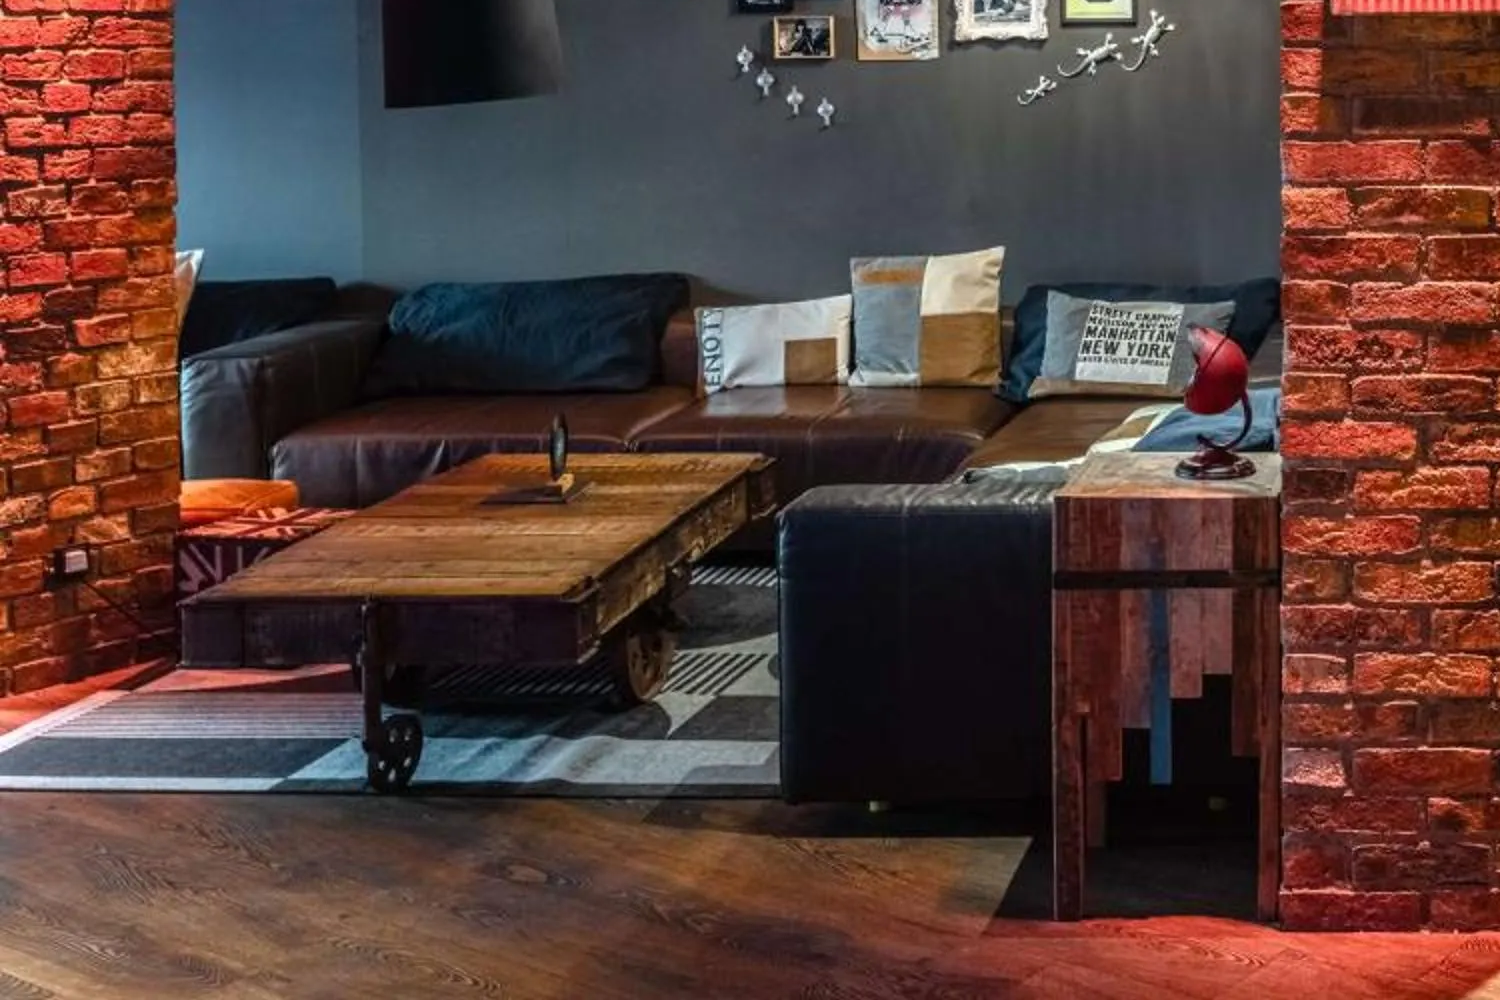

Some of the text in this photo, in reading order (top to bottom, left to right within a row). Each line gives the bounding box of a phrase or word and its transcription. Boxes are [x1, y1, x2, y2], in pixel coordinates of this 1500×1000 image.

[1085, 325, 1177, 342] MANHATTAN
[1080, 339, 1171, 359] NEW YORK
